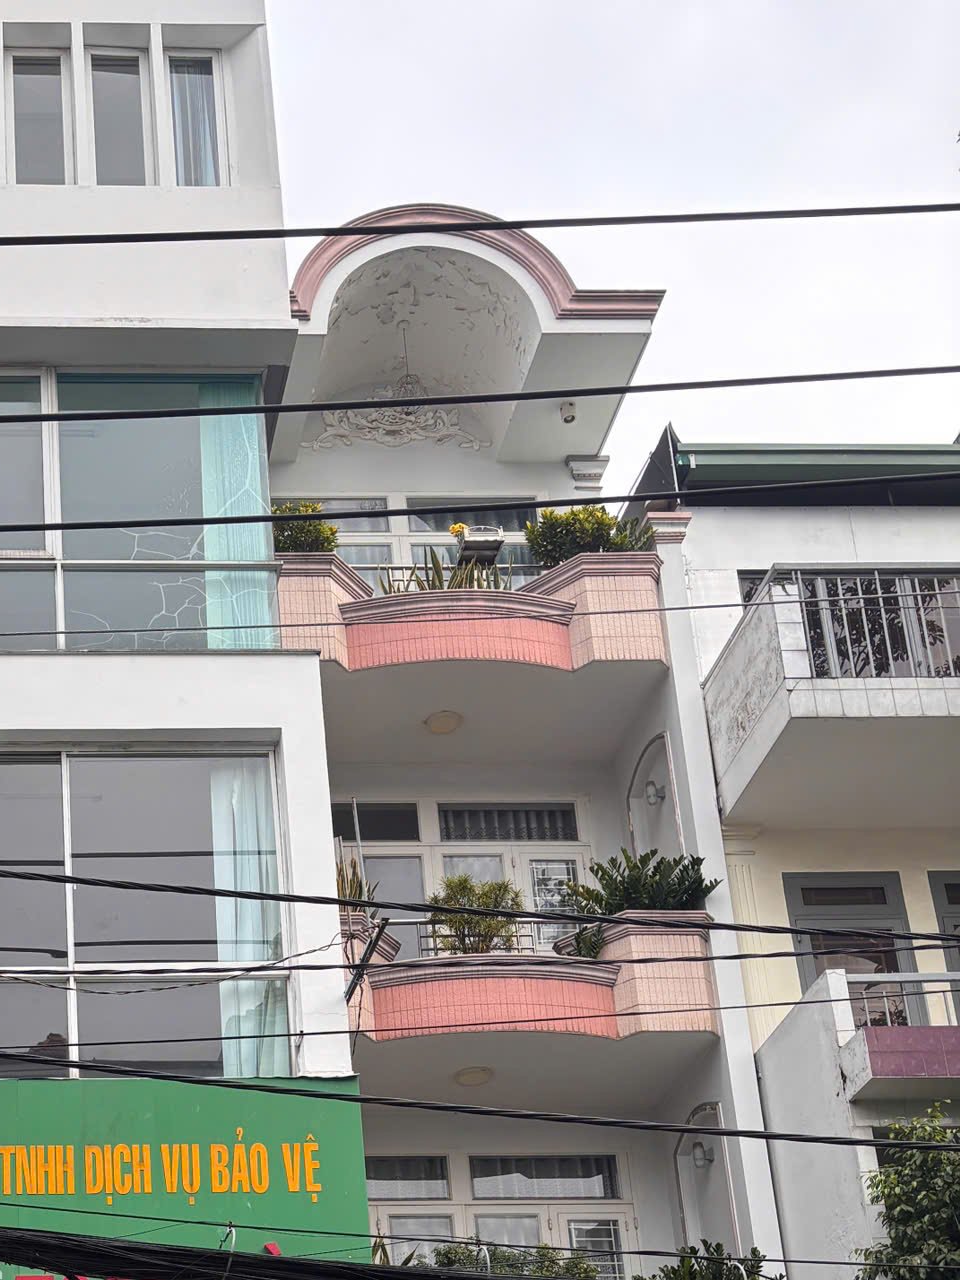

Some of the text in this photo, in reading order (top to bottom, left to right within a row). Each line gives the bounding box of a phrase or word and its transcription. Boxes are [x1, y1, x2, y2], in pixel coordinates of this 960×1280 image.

[85, 1144, 153, 1206] DỊCH
[161, 1144, 201, 1206] VỤ
[210, 1127, 270, 1194] BẢO
[282, 1134, 322, 1203] VỆ
